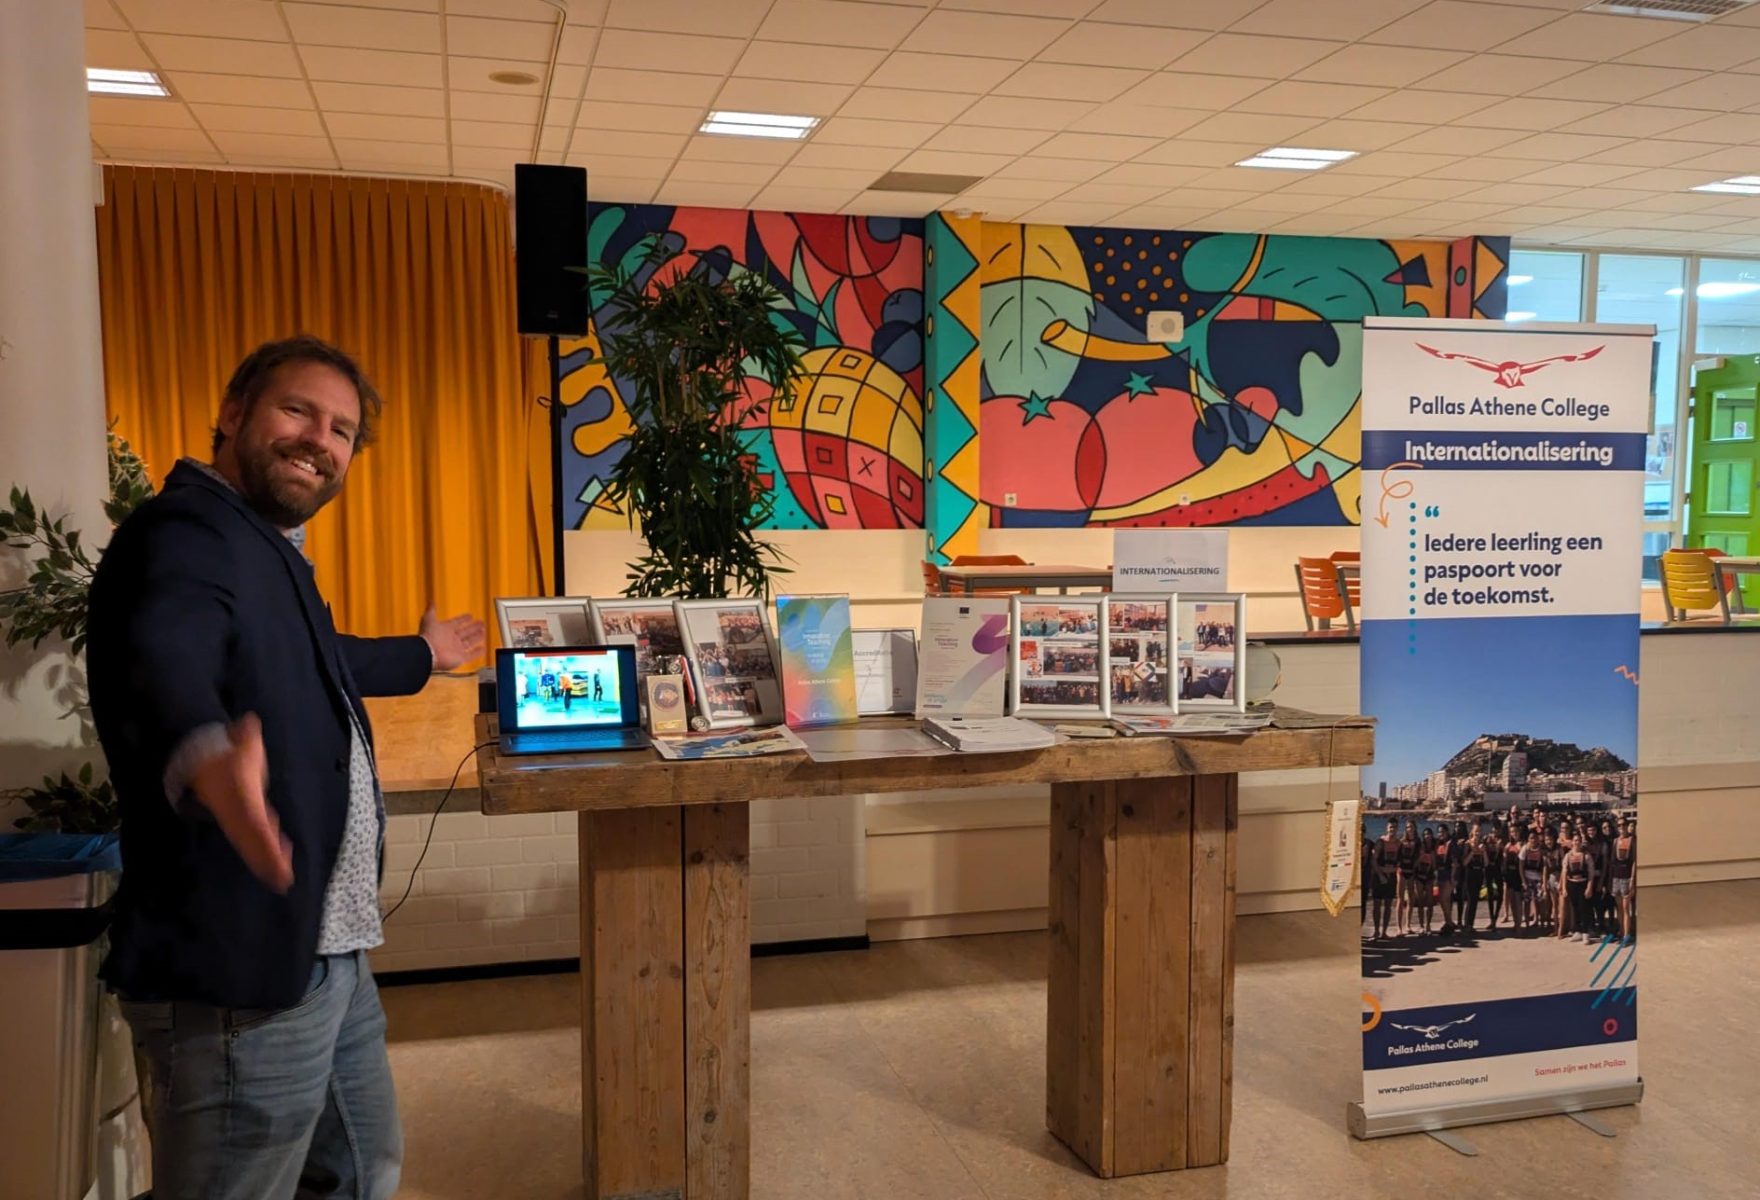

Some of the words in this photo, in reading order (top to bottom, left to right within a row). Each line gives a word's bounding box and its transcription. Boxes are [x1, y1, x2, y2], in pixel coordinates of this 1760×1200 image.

[1409, 396, 1465, 416] Pallas
[1469, 397, 1537, 416] Athene
[1541, 398, 1610, 420] College
[1405, 440, 1614, 466] Internationalisering
[1424, 533, 1486, 552] Iedere
[1491, 532, 1562, 555] leerling
[1566, 535, 1603, 550] een
[1119, 567, 1220, 576] INTERNATIONALISERING
[1424, 561, 1515, 583] paspoort
[1519, 562, 1562, 577] voor
[1424, 587, 1448, 605] de
[1452, 586, 1554, 605] toekomst.
[1388, 1046, 1414, 1056] Pallas
[1415, 1042, 1446, 1053] Athene
[1446, 1038, 1479, 1049] College
[1534, 1066, 1561, 1076] Samen
[1563, 1064, 1576, 1074] zijn
[1589, 1062, 1602, 1070] het
[1603, 1059, 1626, 1067] Pallas
[1378, 1075, 1489, 1094] www.pallasathenecollege.nl
